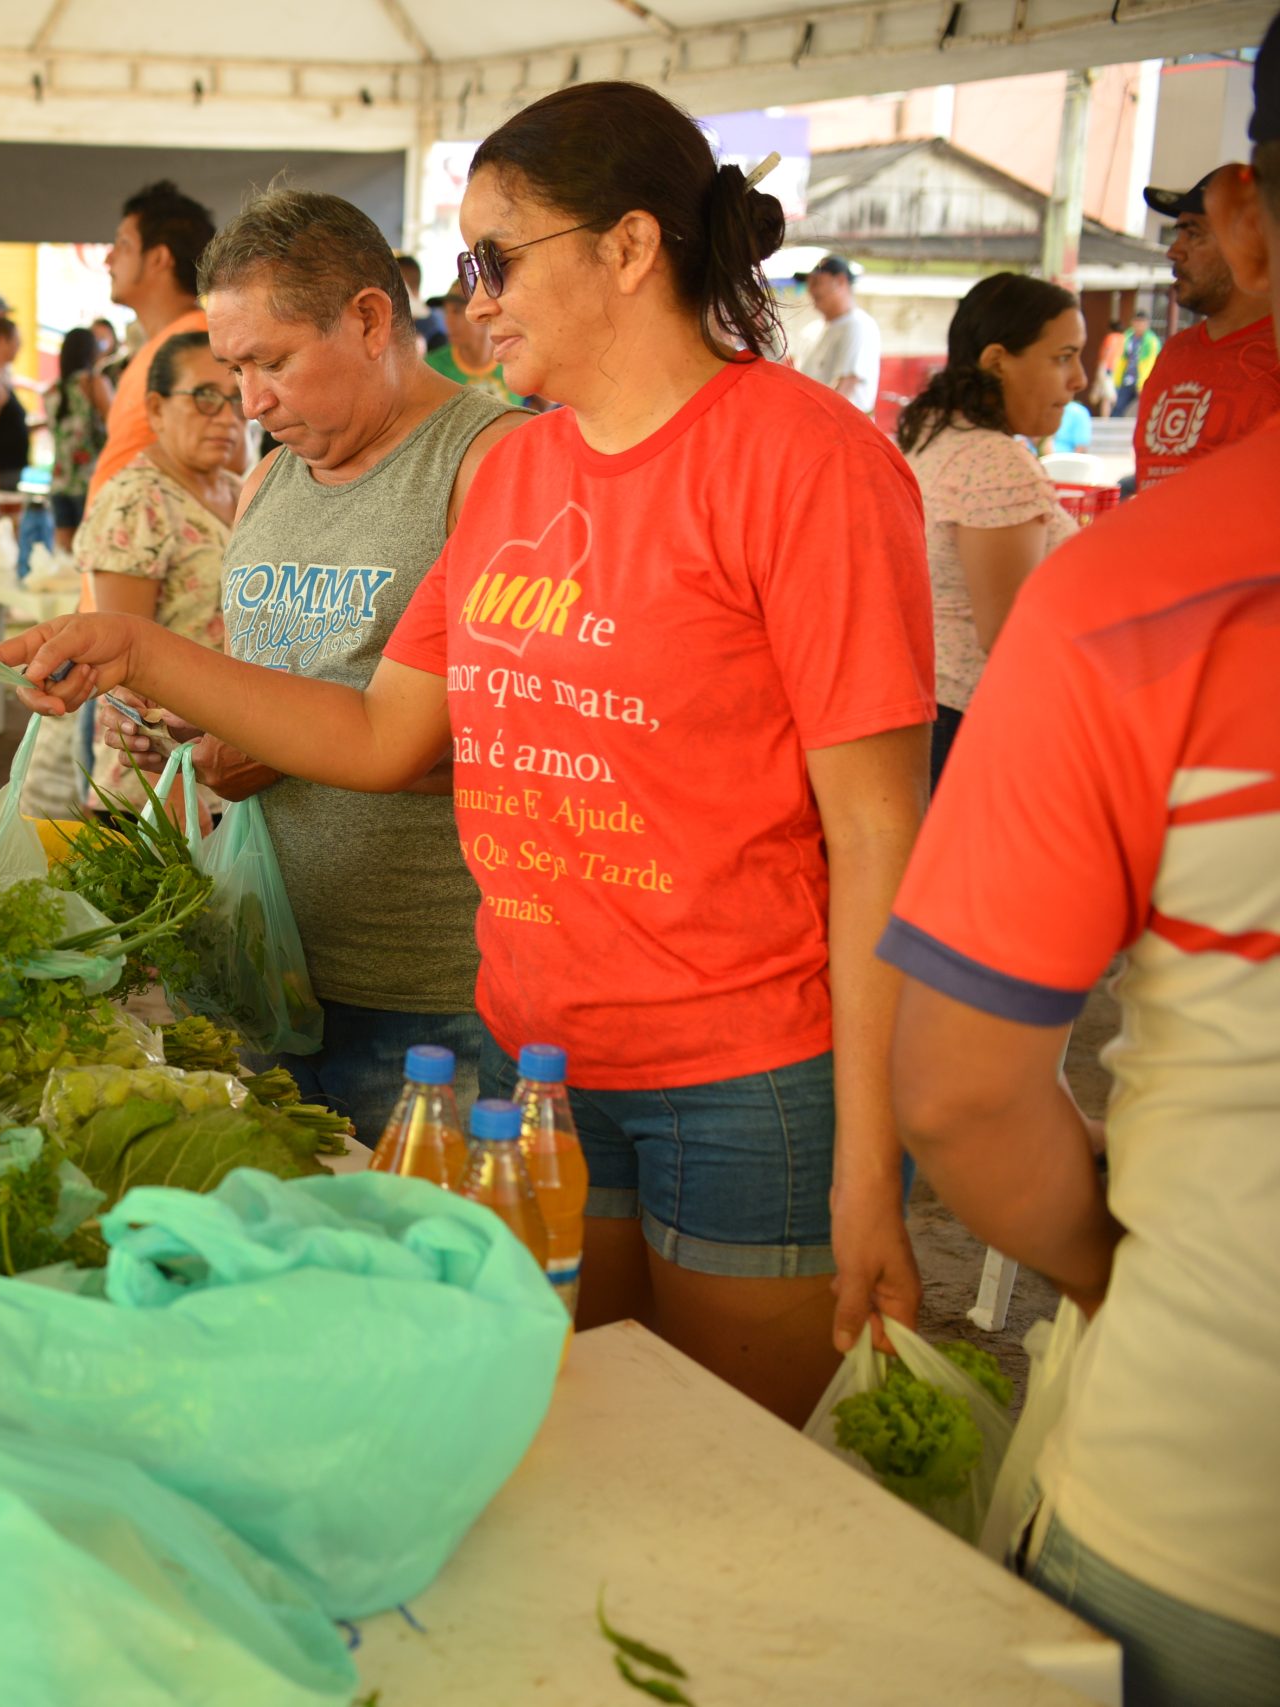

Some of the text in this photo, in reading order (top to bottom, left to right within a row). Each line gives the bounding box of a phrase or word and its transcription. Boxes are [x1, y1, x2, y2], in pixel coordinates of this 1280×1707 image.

[1164, 408, 1187, 437] G
[224, 561, 396, 621] TOMMY
[458, 573, 616, 647] AMOR te
[231, 596, 363, 669] Hilfiger
[322, 628, 363, 657] 1985
[487, 667, 542, 708] que
[552, 679, 660, 733] mata,
[488, 729, 506, 768] é
[549, 796, 646, 837] Ajude
[517, 840, 569, 882] Seja
[579, 851, 674, 894] Tarde
[485, 893, 561, 926] emais.
